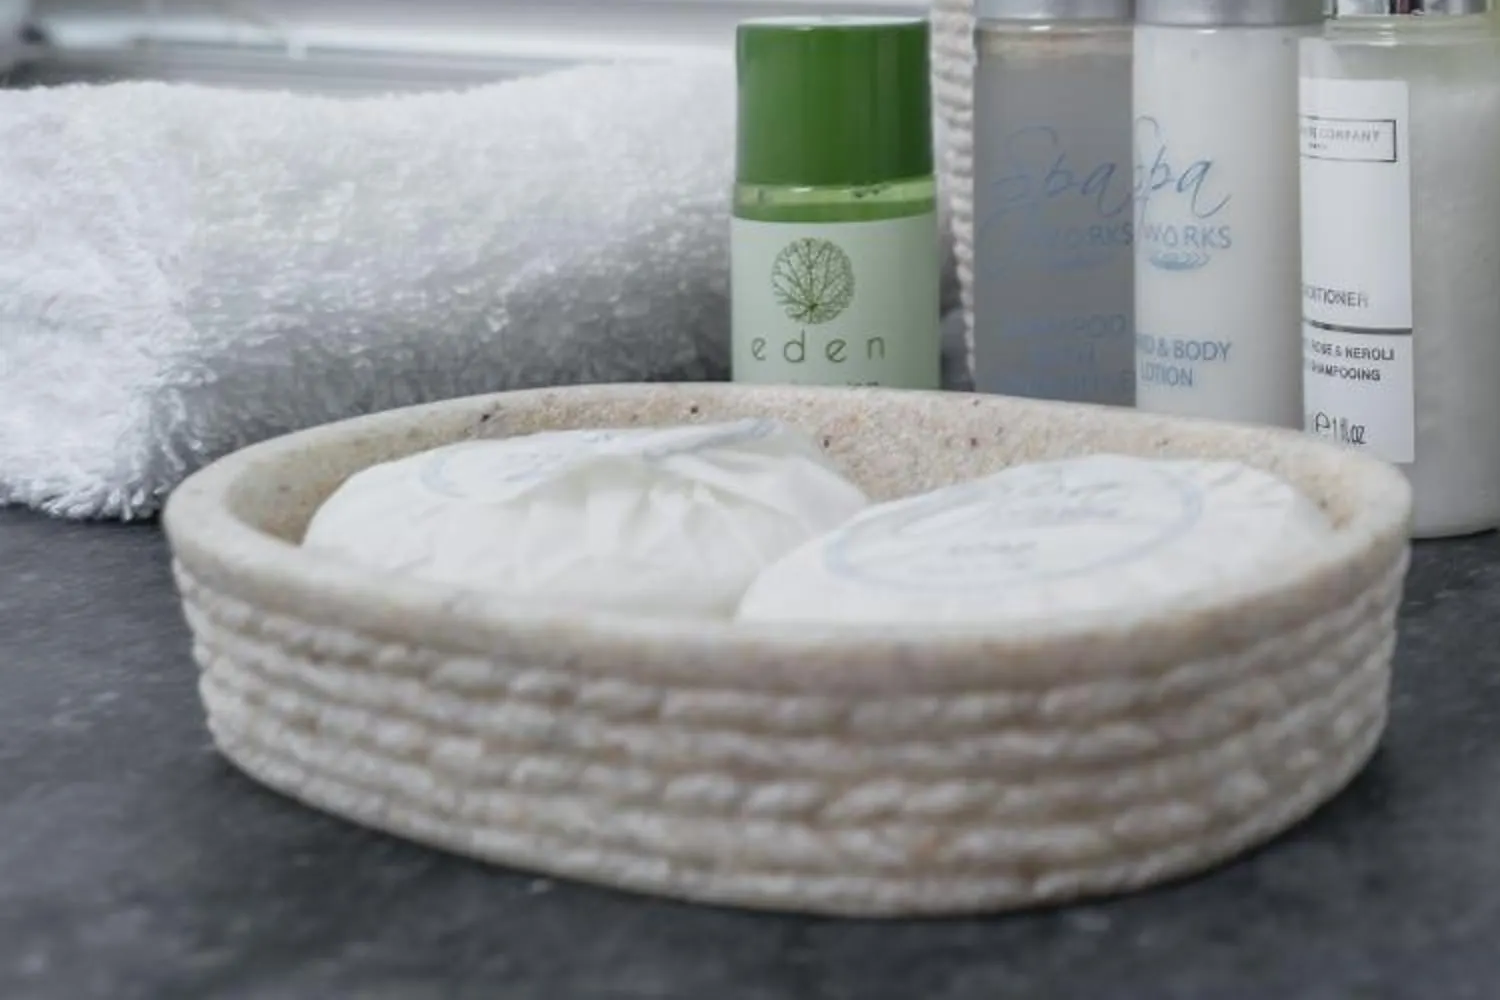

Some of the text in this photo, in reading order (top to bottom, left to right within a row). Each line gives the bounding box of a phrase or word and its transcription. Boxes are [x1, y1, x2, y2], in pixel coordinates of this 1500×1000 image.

[751, 329, 886, 364] eden
[1173, 339, 1233, 363] BODY
[1345, 346, 1395, 361] NEROLI
[1140, 361, 1193, 388] LOTION
